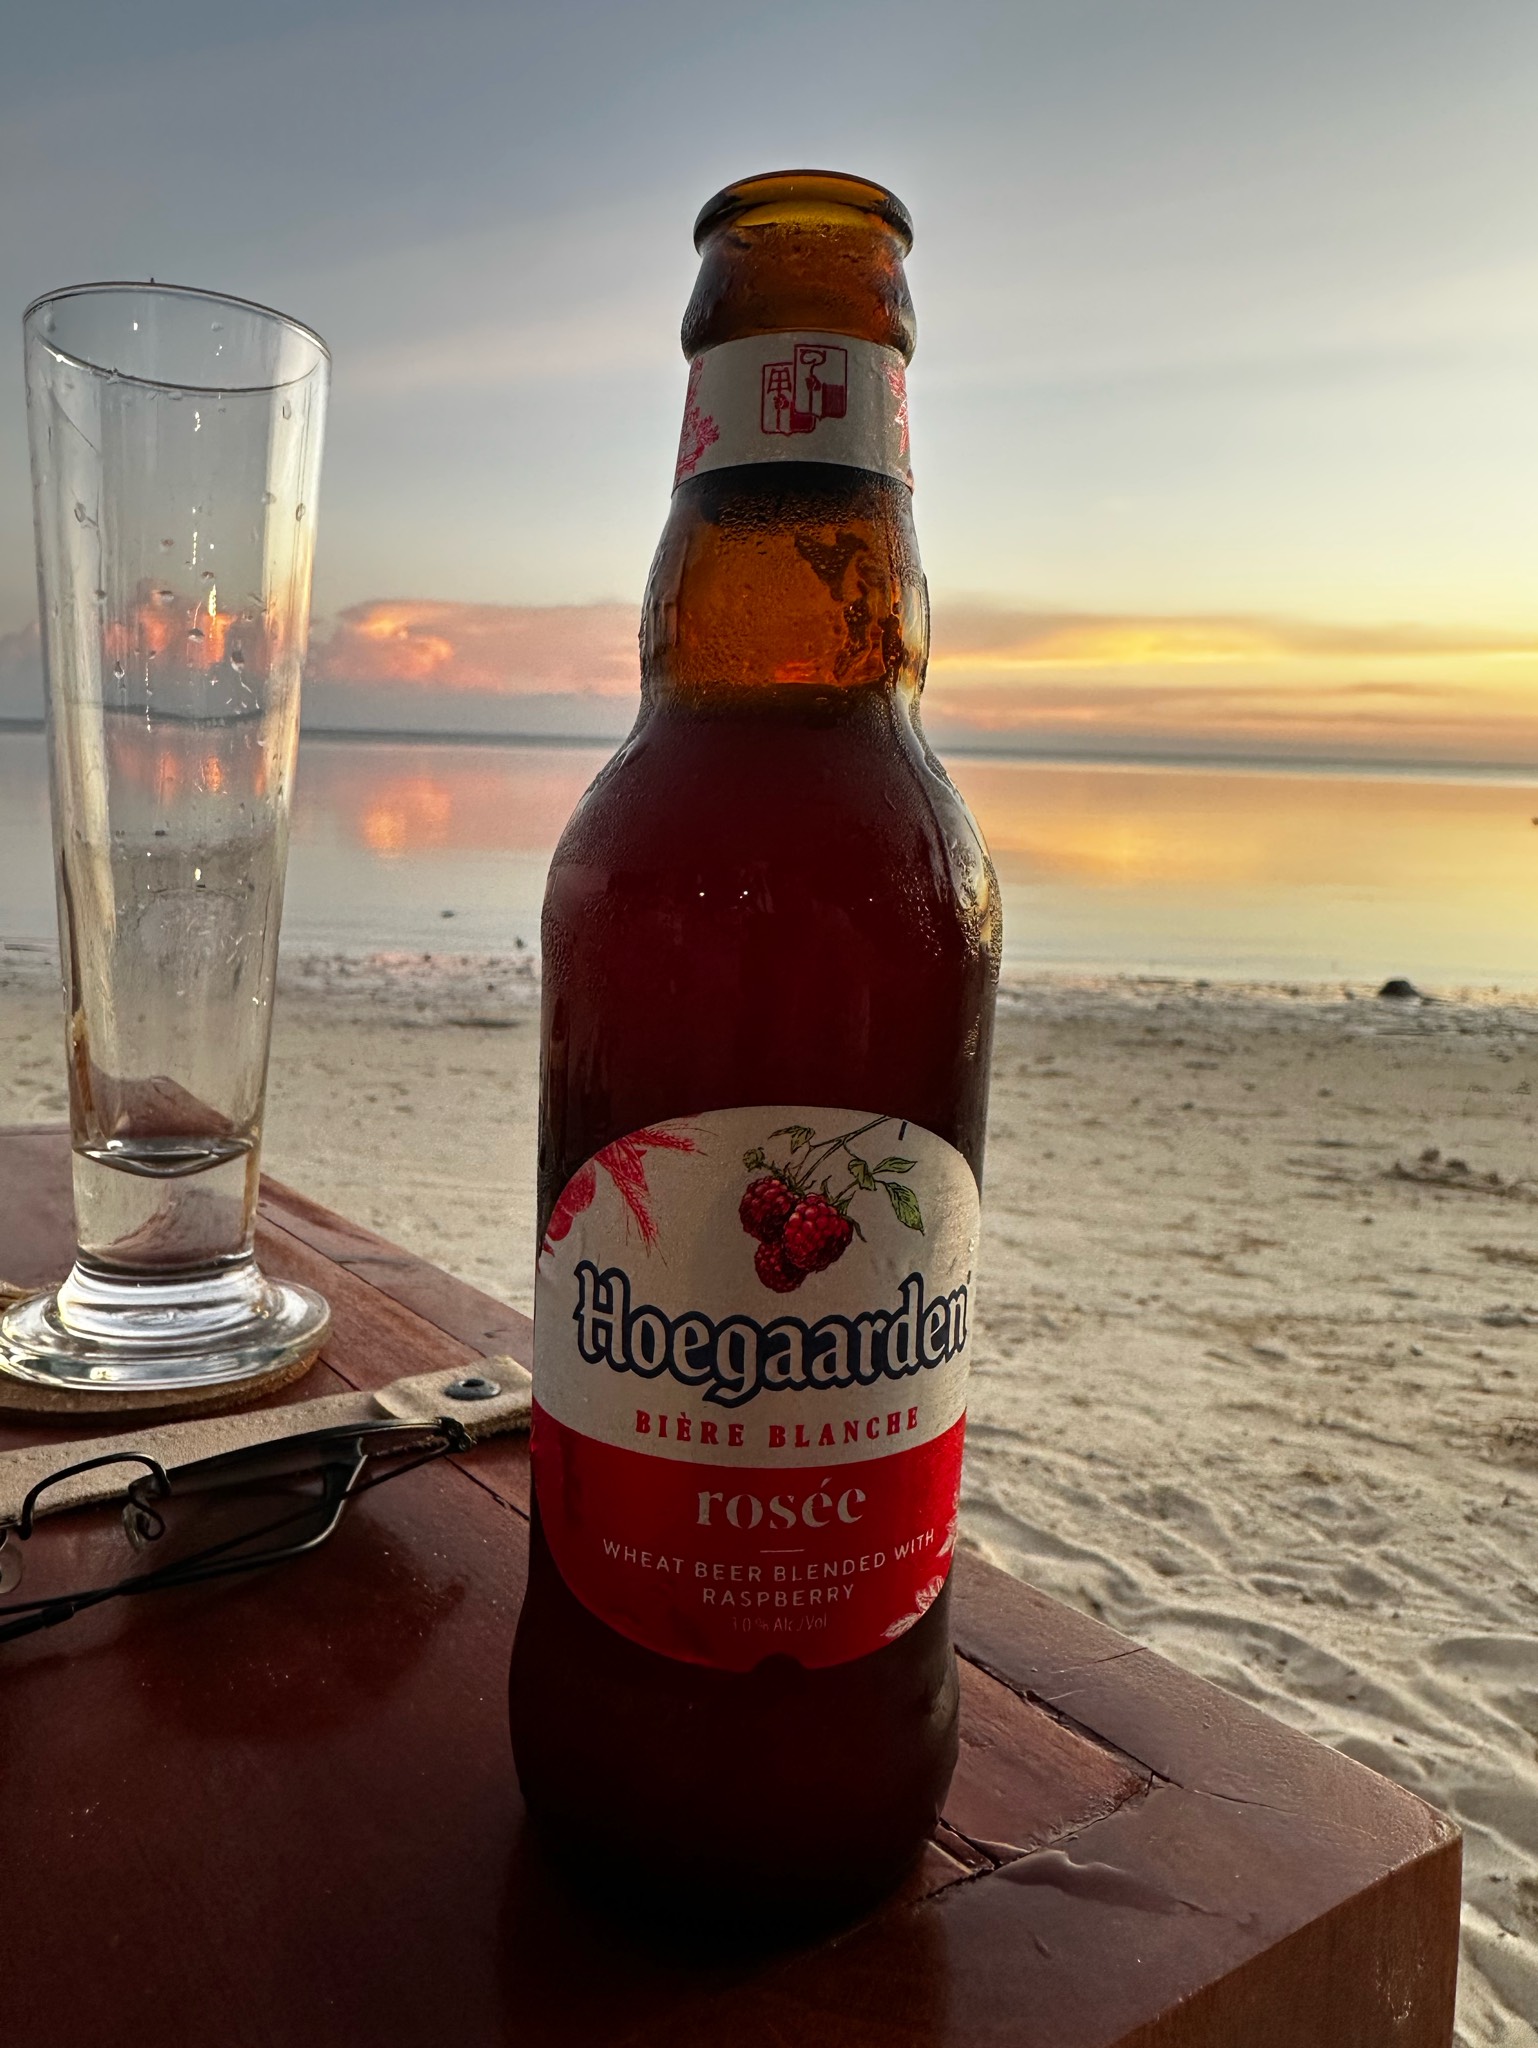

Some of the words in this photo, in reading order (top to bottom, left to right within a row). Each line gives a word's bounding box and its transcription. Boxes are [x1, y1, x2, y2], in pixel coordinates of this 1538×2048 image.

[573, 1260, 968, 1408] Hoegaarden
[636, 1410, 745, 1447] BIÈRE
[769, 1406, 919, 1448] BLANCHE
[696, 1477, 867, 1530] rosée
[603, 1538, 685, 1574] WHEAT
[695, 1562, 762, 1582] BEER
[774, 1551, 886, 1582] BLENDED
[894, 1528, 935, 1561] WITH
[702, 1584, 855, 1607] RASPBERRY
